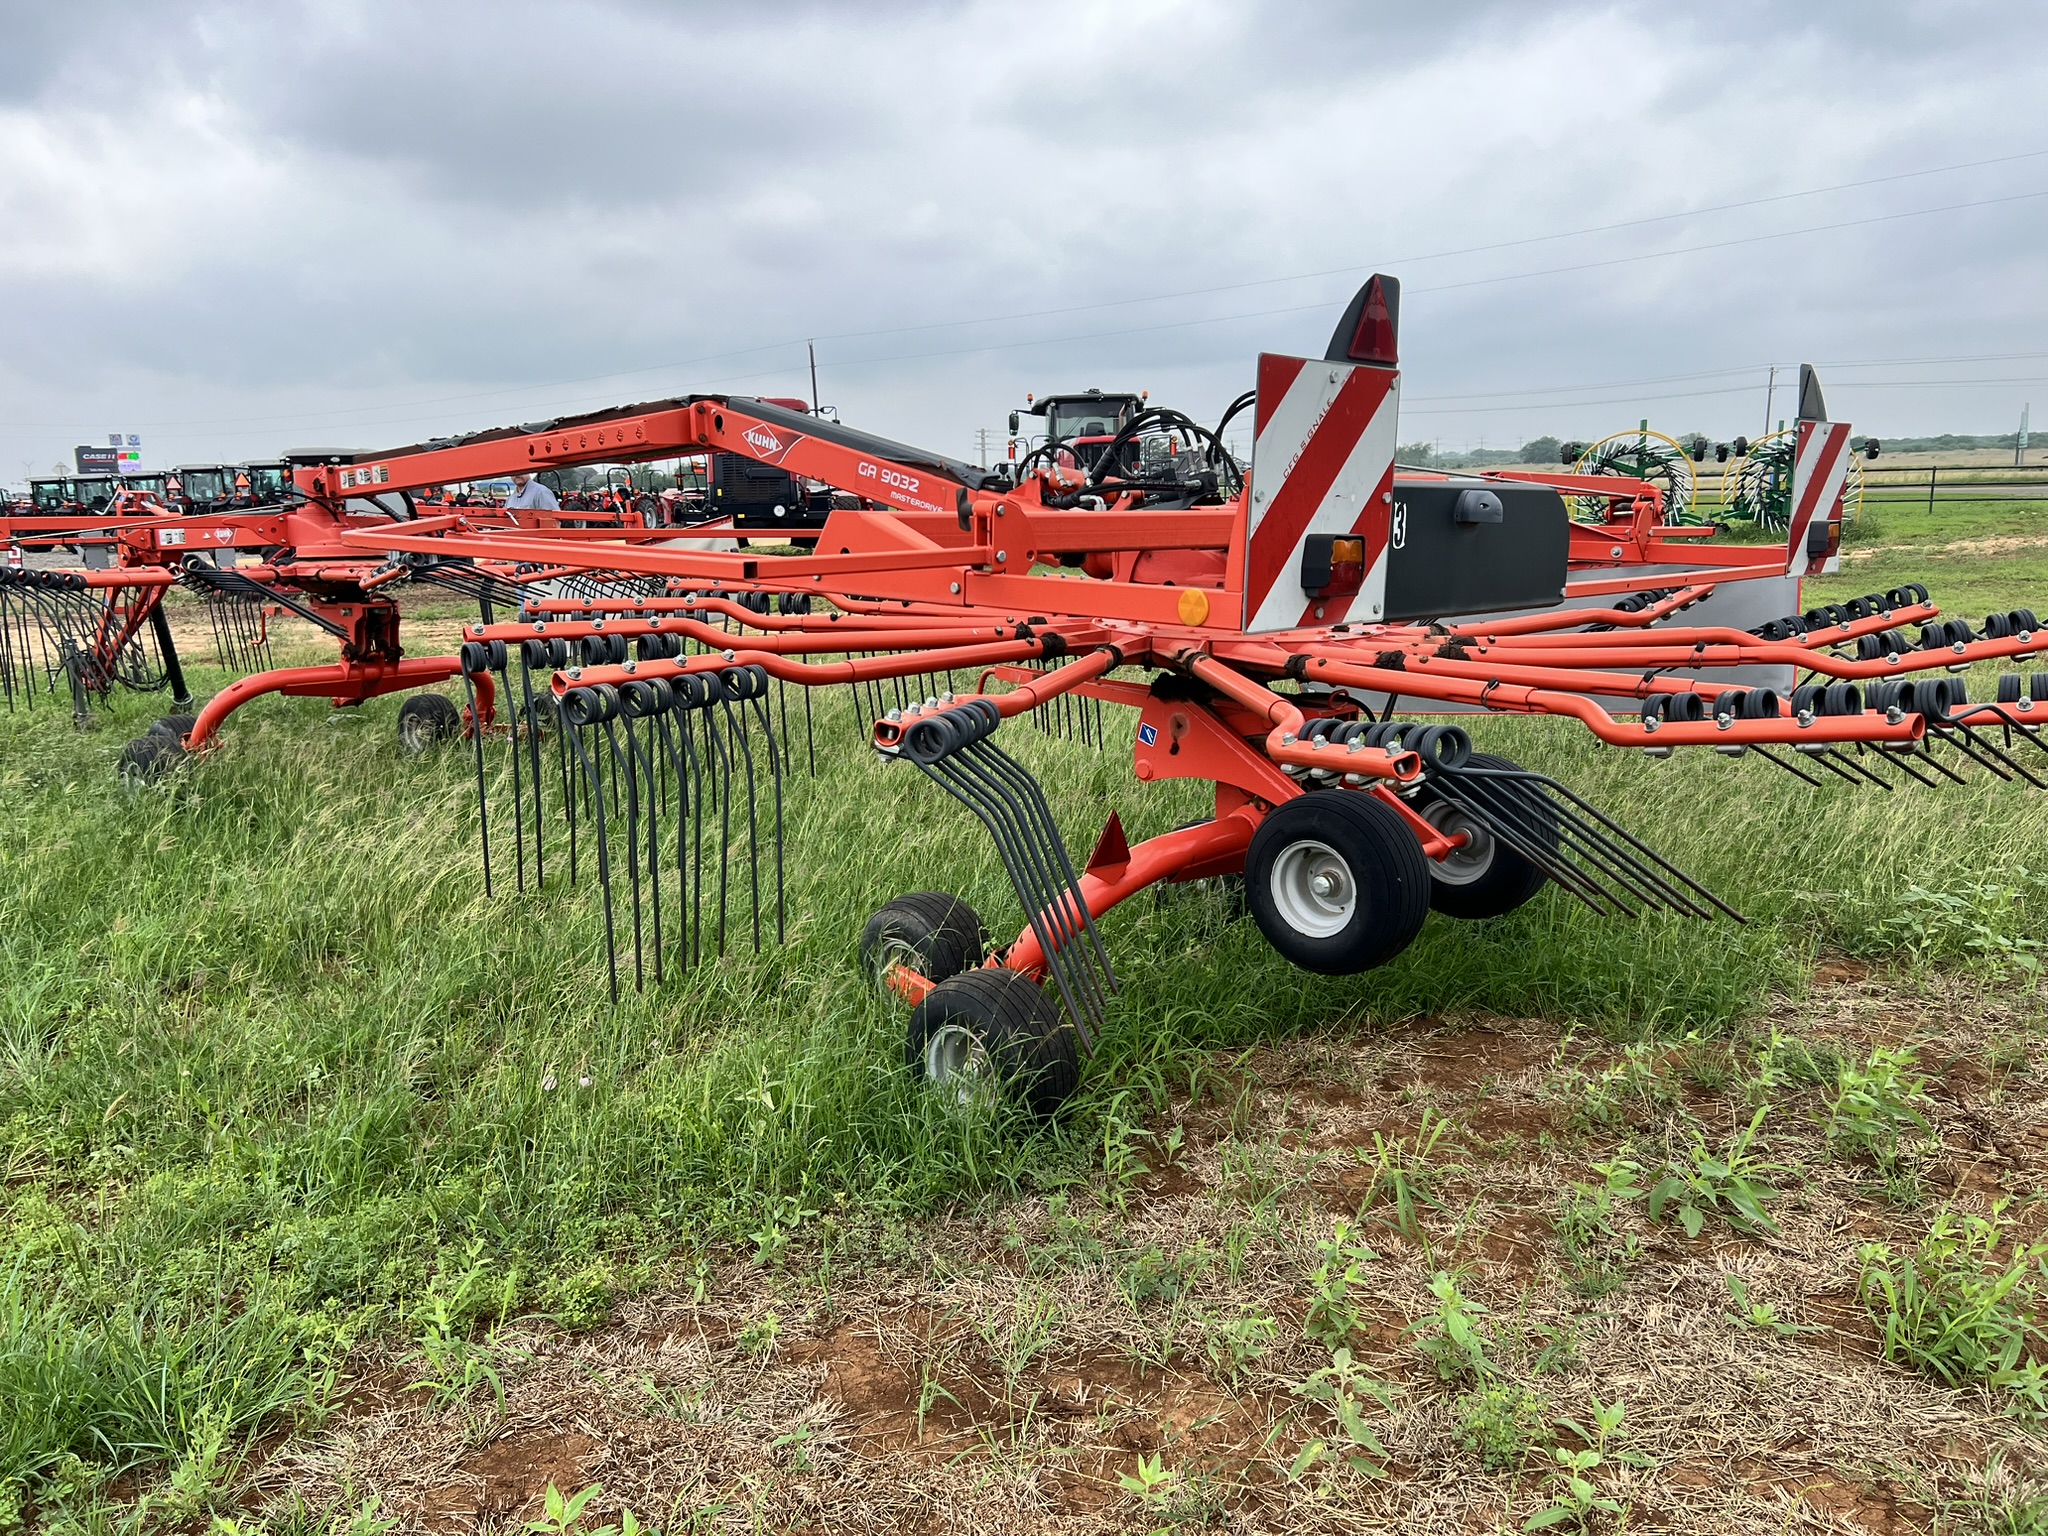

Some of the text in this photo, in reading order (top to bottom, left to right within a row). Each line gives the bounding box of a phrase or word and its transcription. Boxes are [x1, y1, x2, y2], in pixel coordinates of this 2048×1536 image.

[1300, 397, 1333, 451] SGNALE
[747, 430, 777, 451] KUHN
[858, 461, 920, 493] GA 9032
[890, 490, 944, 512] MASTERDRIVE
